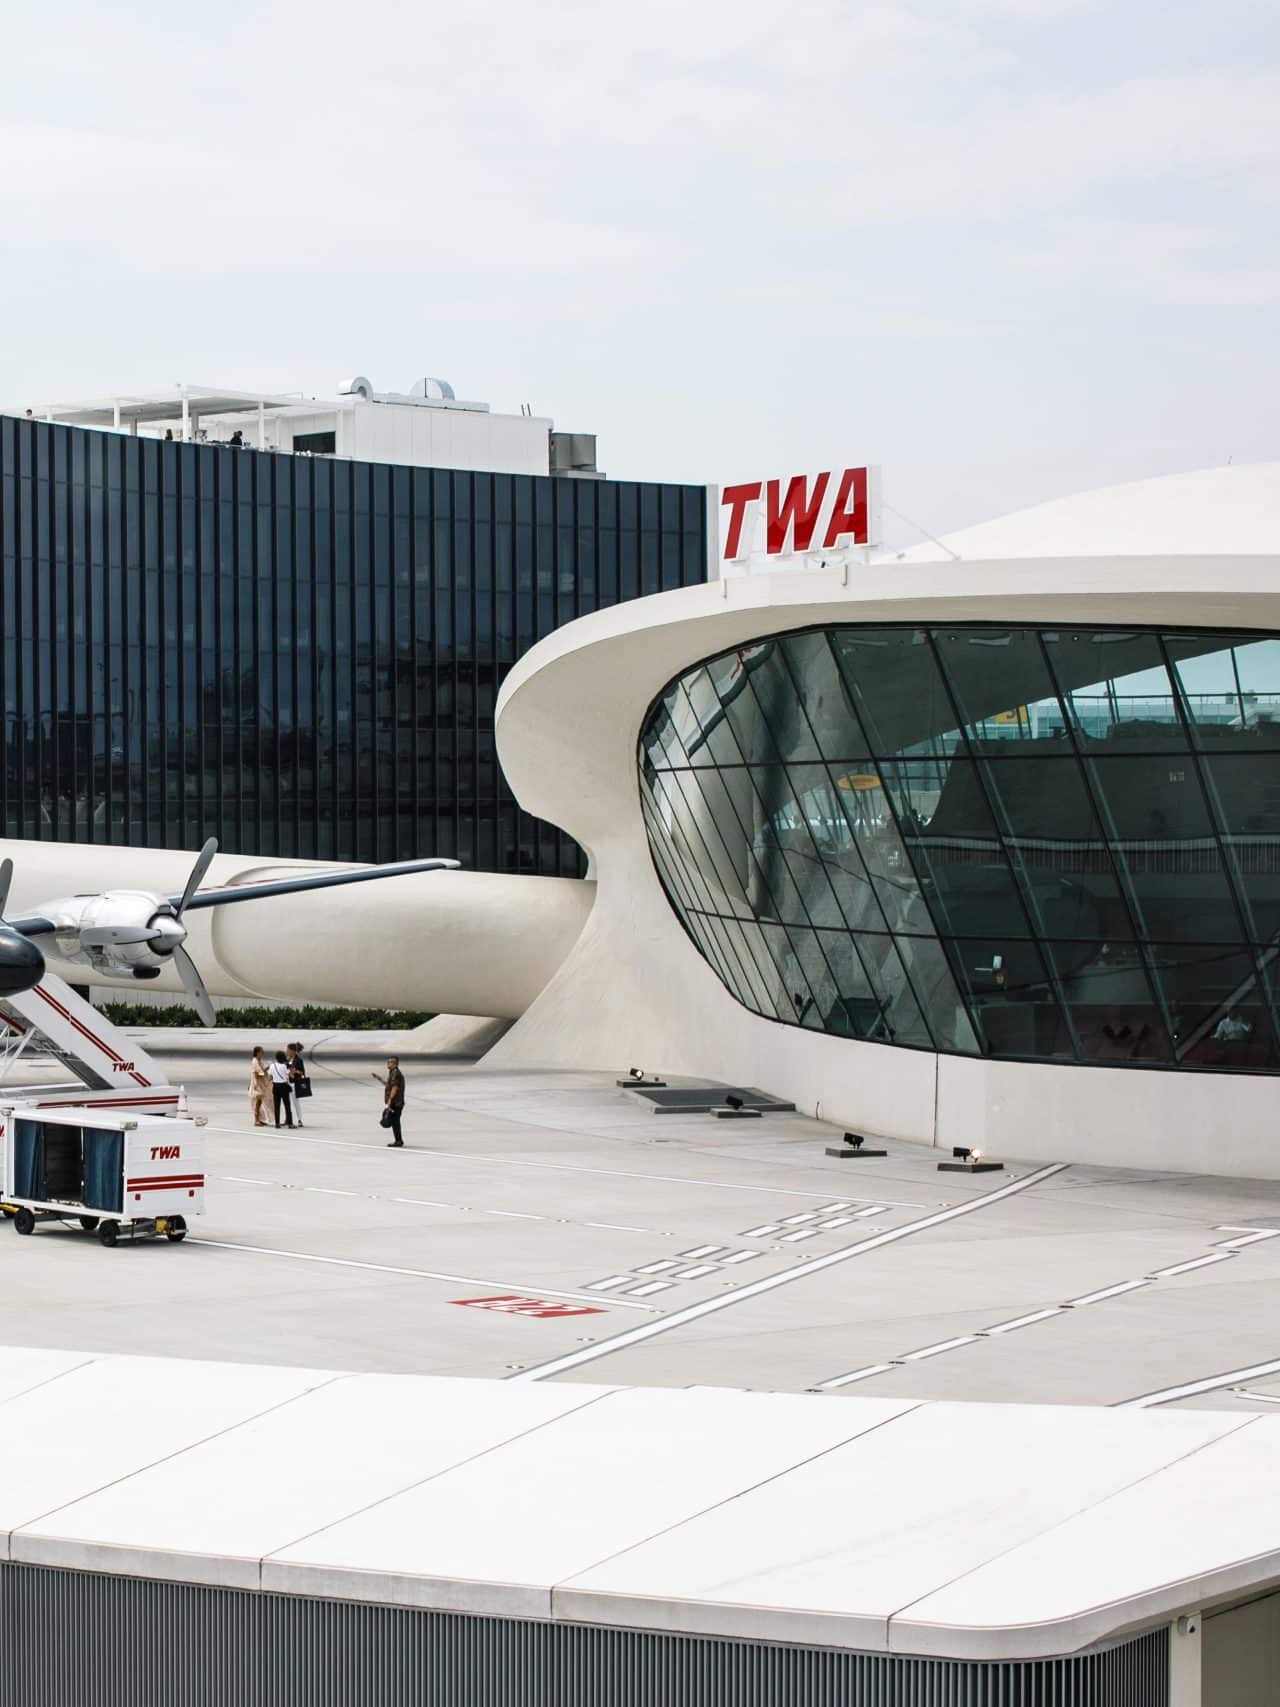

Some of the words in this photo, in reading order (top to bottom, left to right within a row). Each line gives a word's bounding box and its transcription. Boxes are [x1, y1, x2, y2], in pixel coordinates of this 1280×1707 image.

[721, 467, 869, 560] TWA
[112, 1062, 134, 1072] TWA
[150, 1145, 180, 1160] TWA
